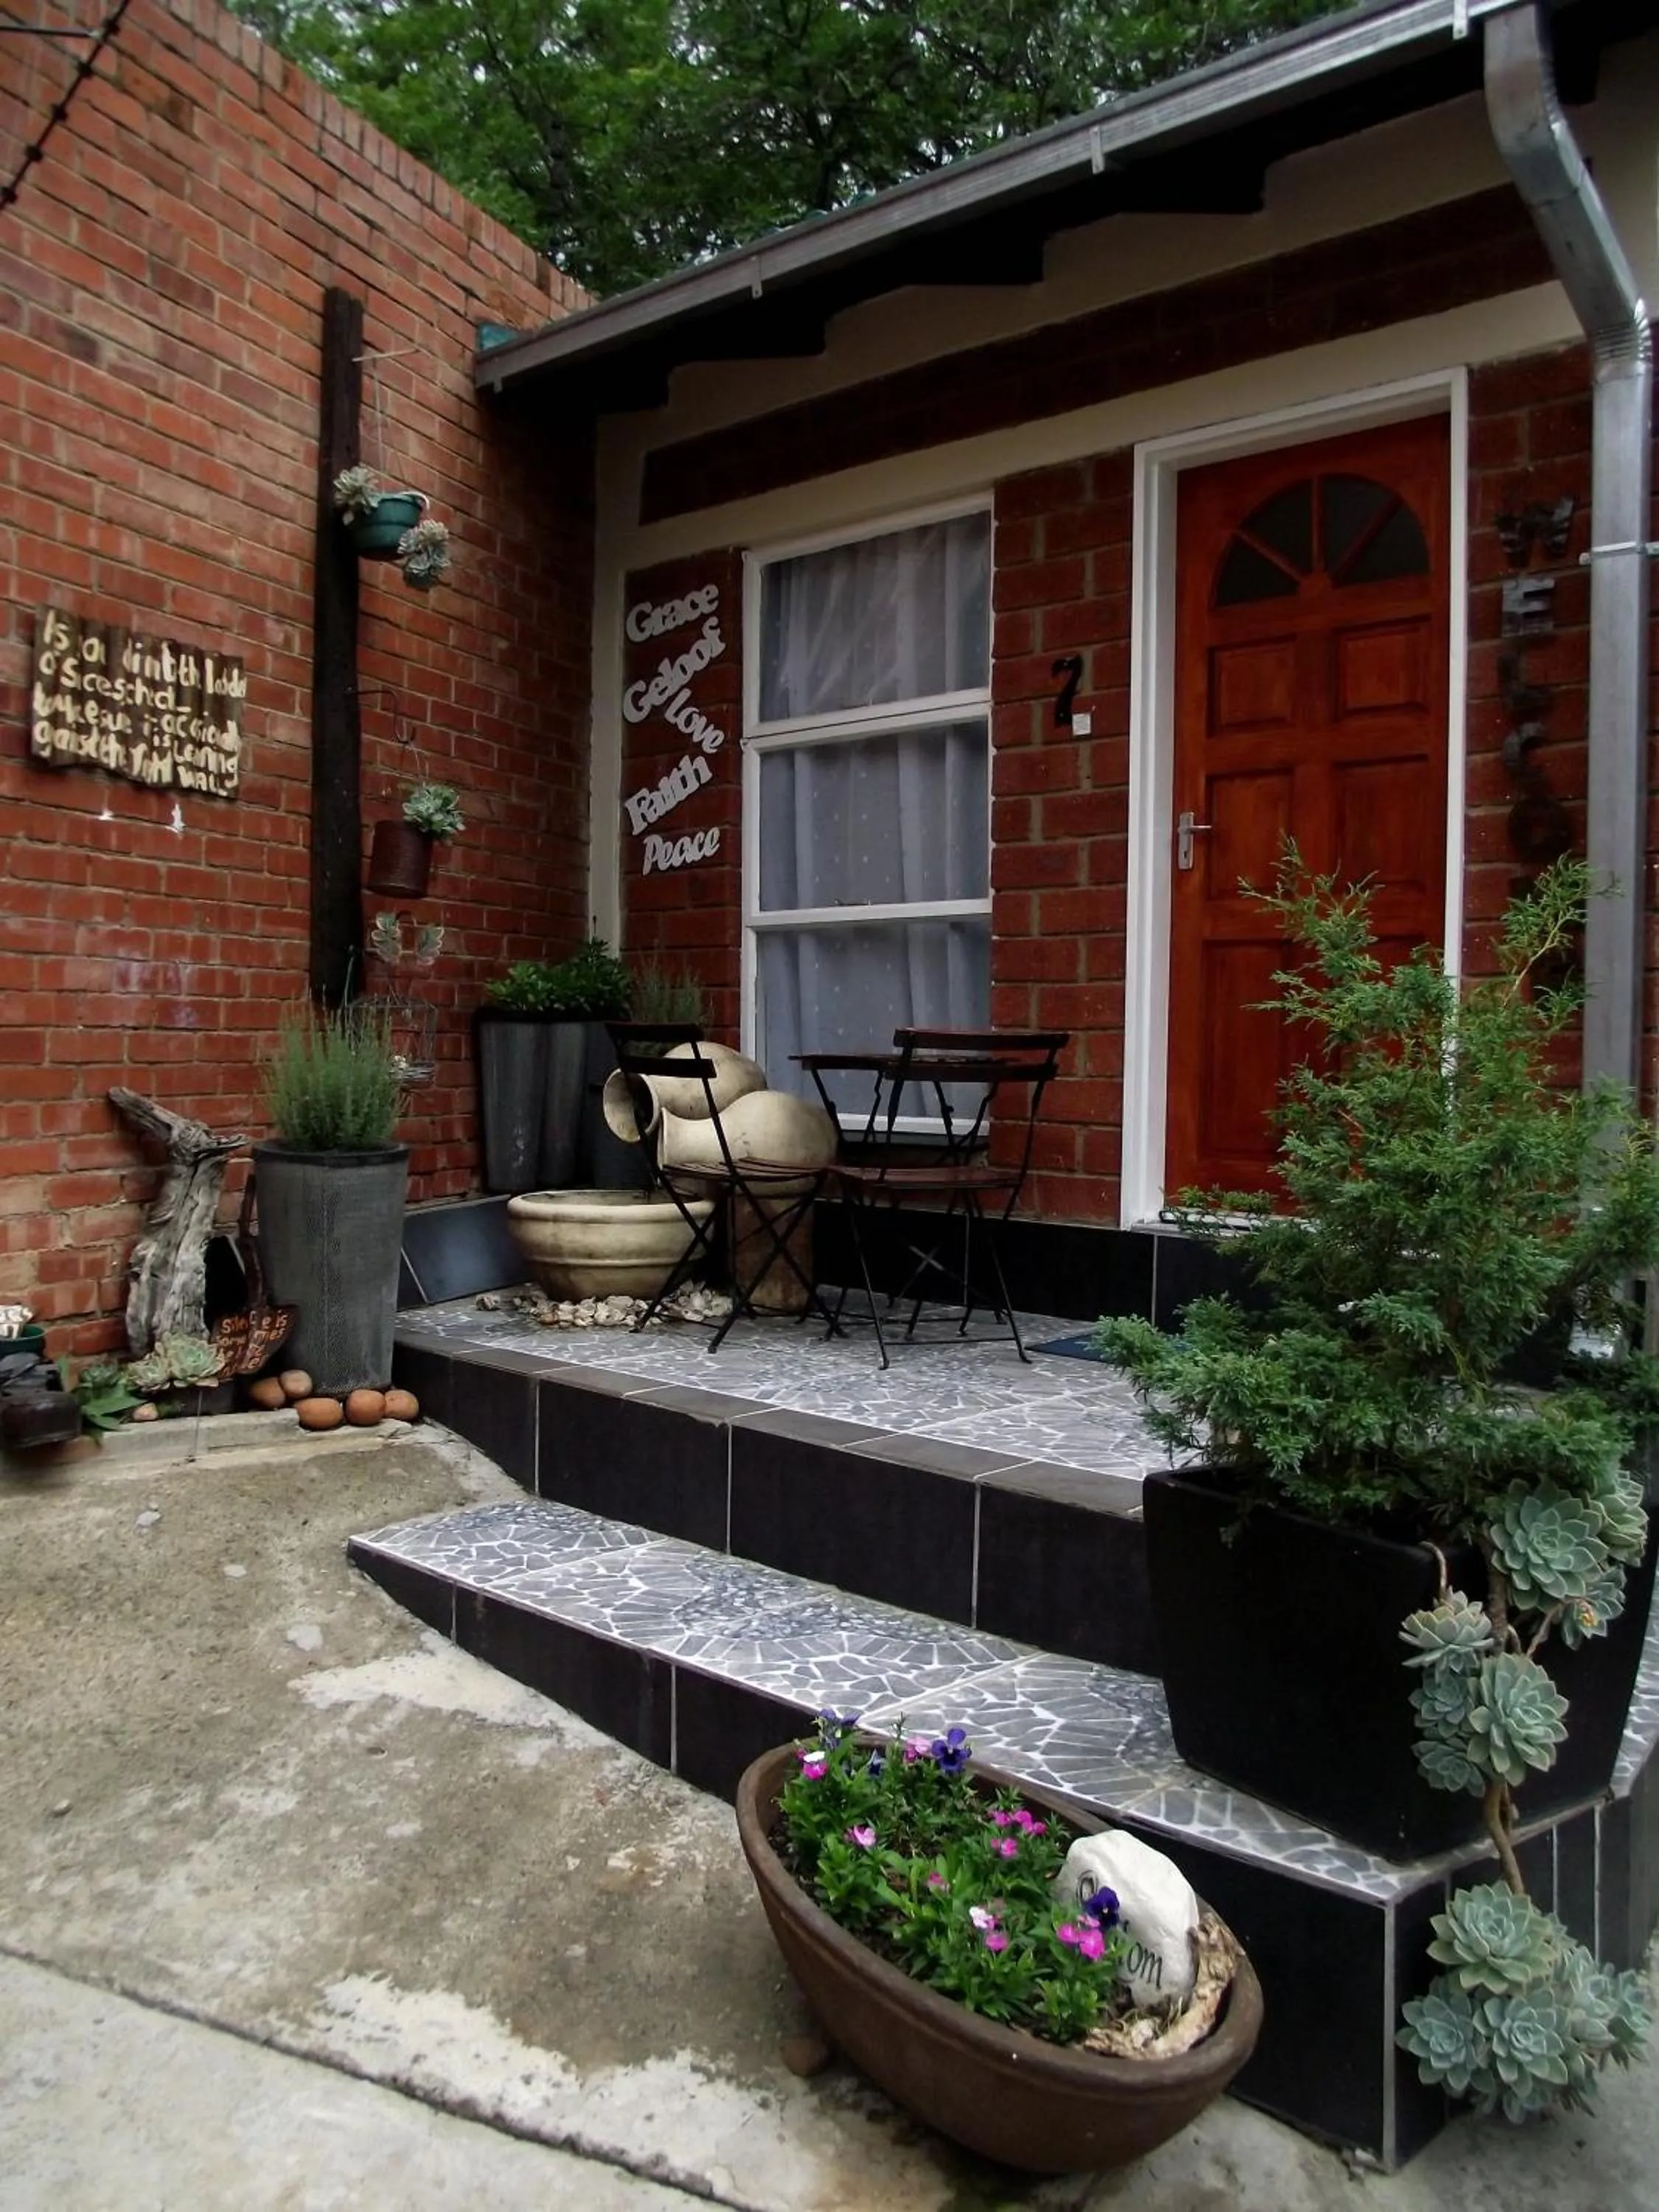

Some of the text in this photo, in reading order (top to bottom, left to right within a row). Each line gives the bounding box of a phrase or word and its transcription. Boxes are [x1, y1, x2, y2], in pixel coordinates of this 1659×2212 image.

[626, 584, 719, 642] Grace
[1051, 655, 1083, 728] 7
[624, 754, 713, 835] Faith
[642, 827, 720, 876] Peace
